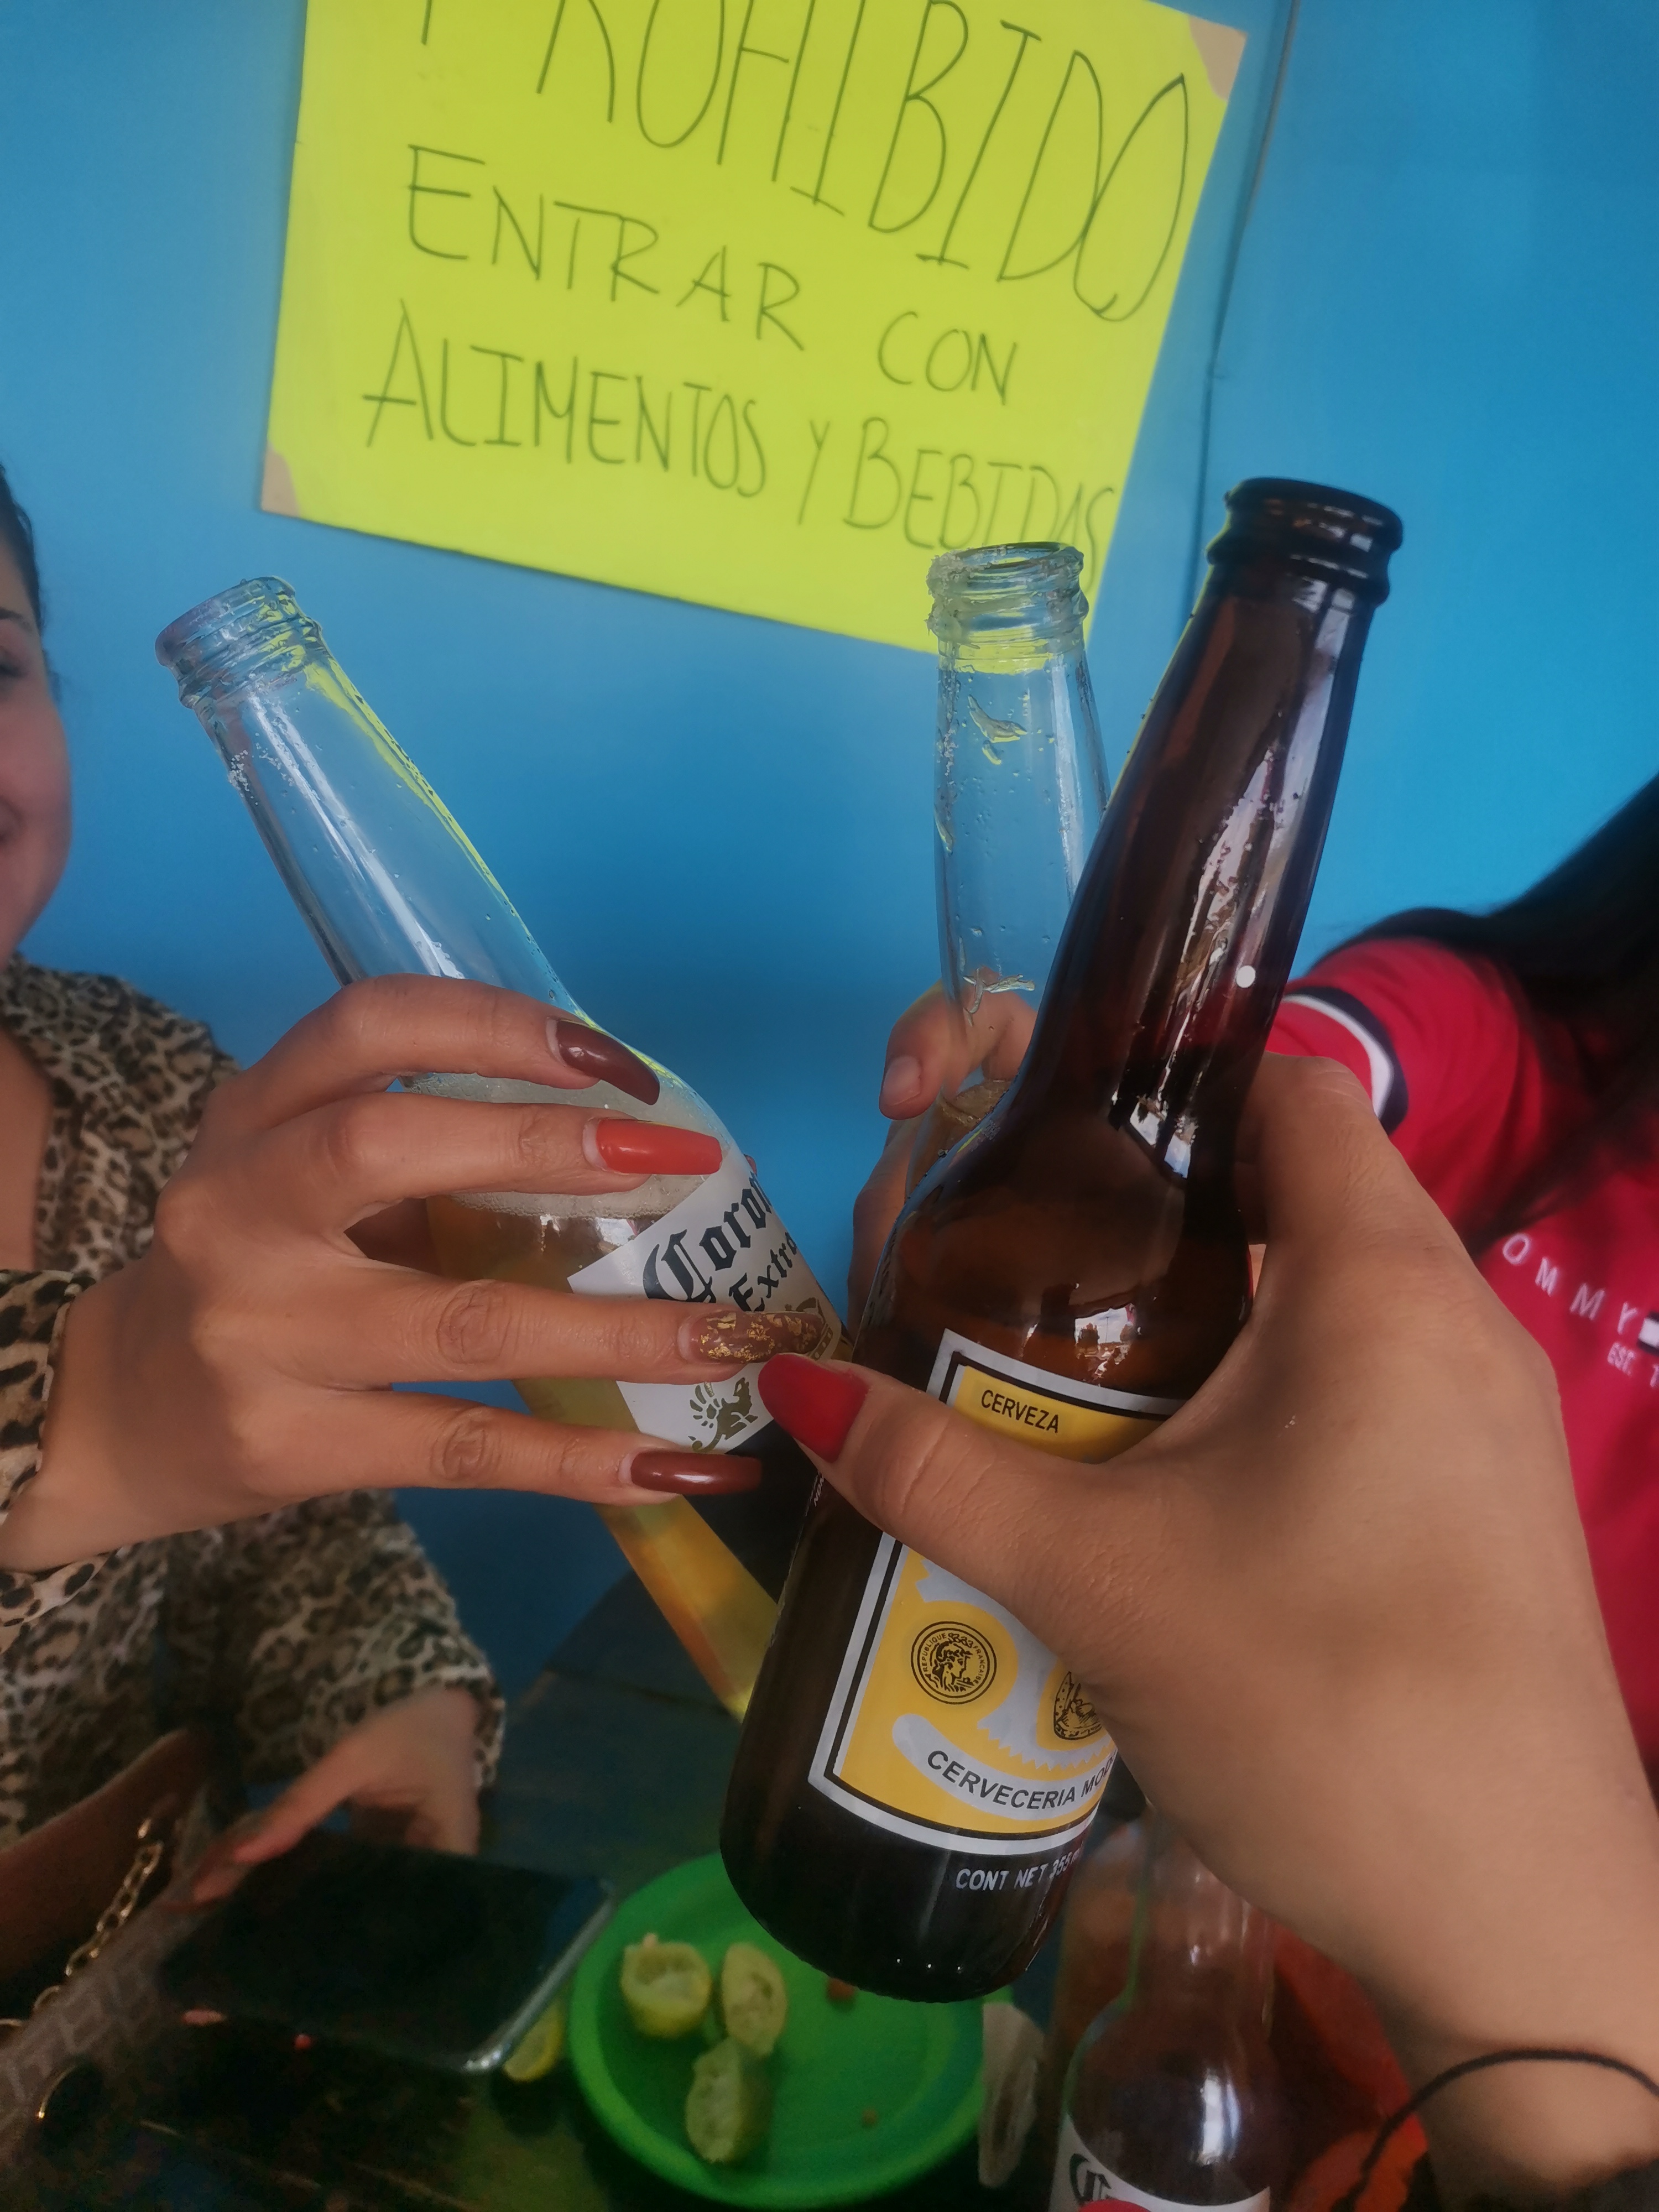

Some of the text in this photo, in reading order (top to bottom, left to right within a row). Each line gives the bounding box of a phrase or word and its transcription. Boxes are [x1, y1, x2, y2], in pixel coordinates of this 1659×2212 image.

[422, 0, 1188, 322] OHIBIDO
[408, 144, 1016, 405] ENTRAR CON
[362, 298, 766, 498] ALIMENTOS
[643, 1171, 772, 1303] Coron
[728, 1232, 797, 1312] Extra
[1502, 1232, 1639, 1335] OMMY
[981, 1390, 1059, 1433] CERVEZA
[921, 1632, 946, 1672] REPUBLIQUE
[927, 1750, 1076, 1809] CERVECERIA
[956, 1868, 1010, 1891] CONT
[1014, 1863, 1048, 1889] NET
